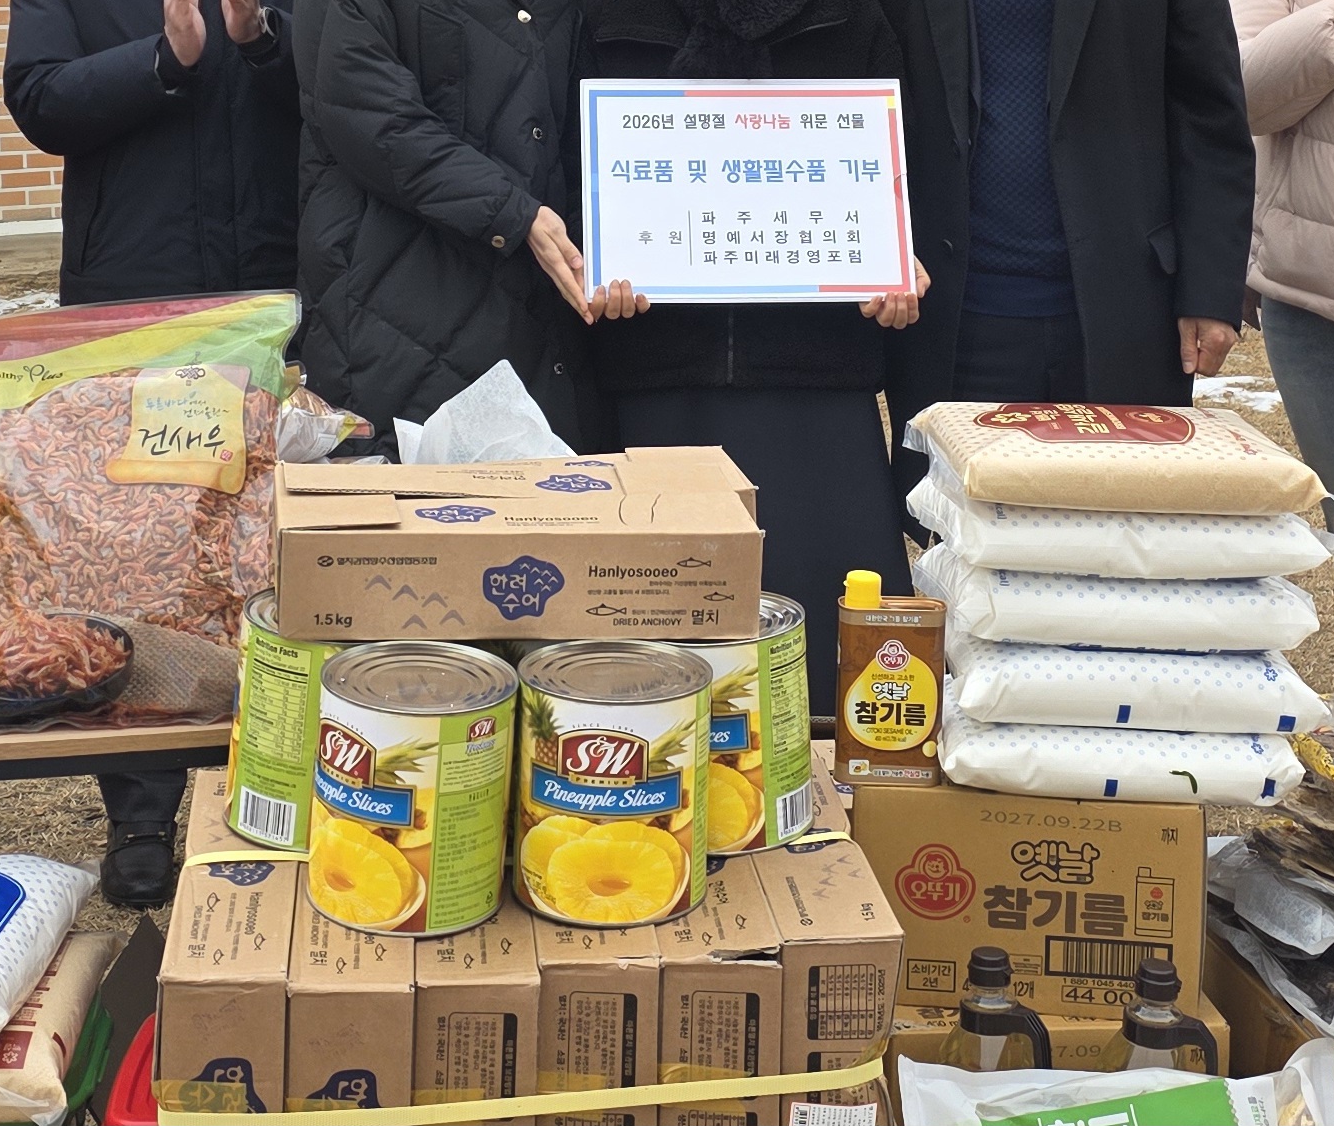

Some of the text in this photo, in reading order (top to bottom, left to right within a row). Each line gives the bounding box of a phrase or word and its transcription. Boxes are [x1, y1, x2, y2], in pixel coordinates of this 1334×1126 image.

[623, 113, 865, 130] 2026년 설명절 사랑나눔 위문 선물
[611, 159, 881, 183] 식료품 및 생활필수품 기부
[23, 364, 63, 382] Plus
[138, 425, 226, 458] 건새우
[588, 565, 678, 580] Hanlyosooeo
[490, 573, 526, 595] 한려
[502, 594, 540, 613] 수어
[613, 618, 682, 626] DRIED ANCHOVY
[691, 609, 719, 625] 멸치
[255, 634, 298, 659] Nutrition Facts
[884, 656, 903, 665] 오뚜기
[871, 682, 911, 701] 옛날
[855, 701, 926, 726] 참기름
[321, 729, 368, 774] S&W
[566, 736, 640, 776] S&W
[575, 777, 629, 786] PREMIUM
[315, 776, 393, 816] neapple Slices
[544, 780, 666, 810] Pineapple Slices
[980, 810, 1178, 845] 2027.09.22B 까지
[1011, 839, 1100, 884] 옛날
[910, 879, 960, 902] 오뚜기
[983, 885, 1128, 937] 참기름
[1141, 911, 1169, 922] 참기름
[911, 963, 951, 976] 소비기간
[922, 976, 938, 988] 2년
[1091, 980, 1112, 988] 1045
[559, 995, 567, 1010] 멸치
[680, 995, 689, 1009] 멸치
[1065, 987, 1095, 1002] 44
